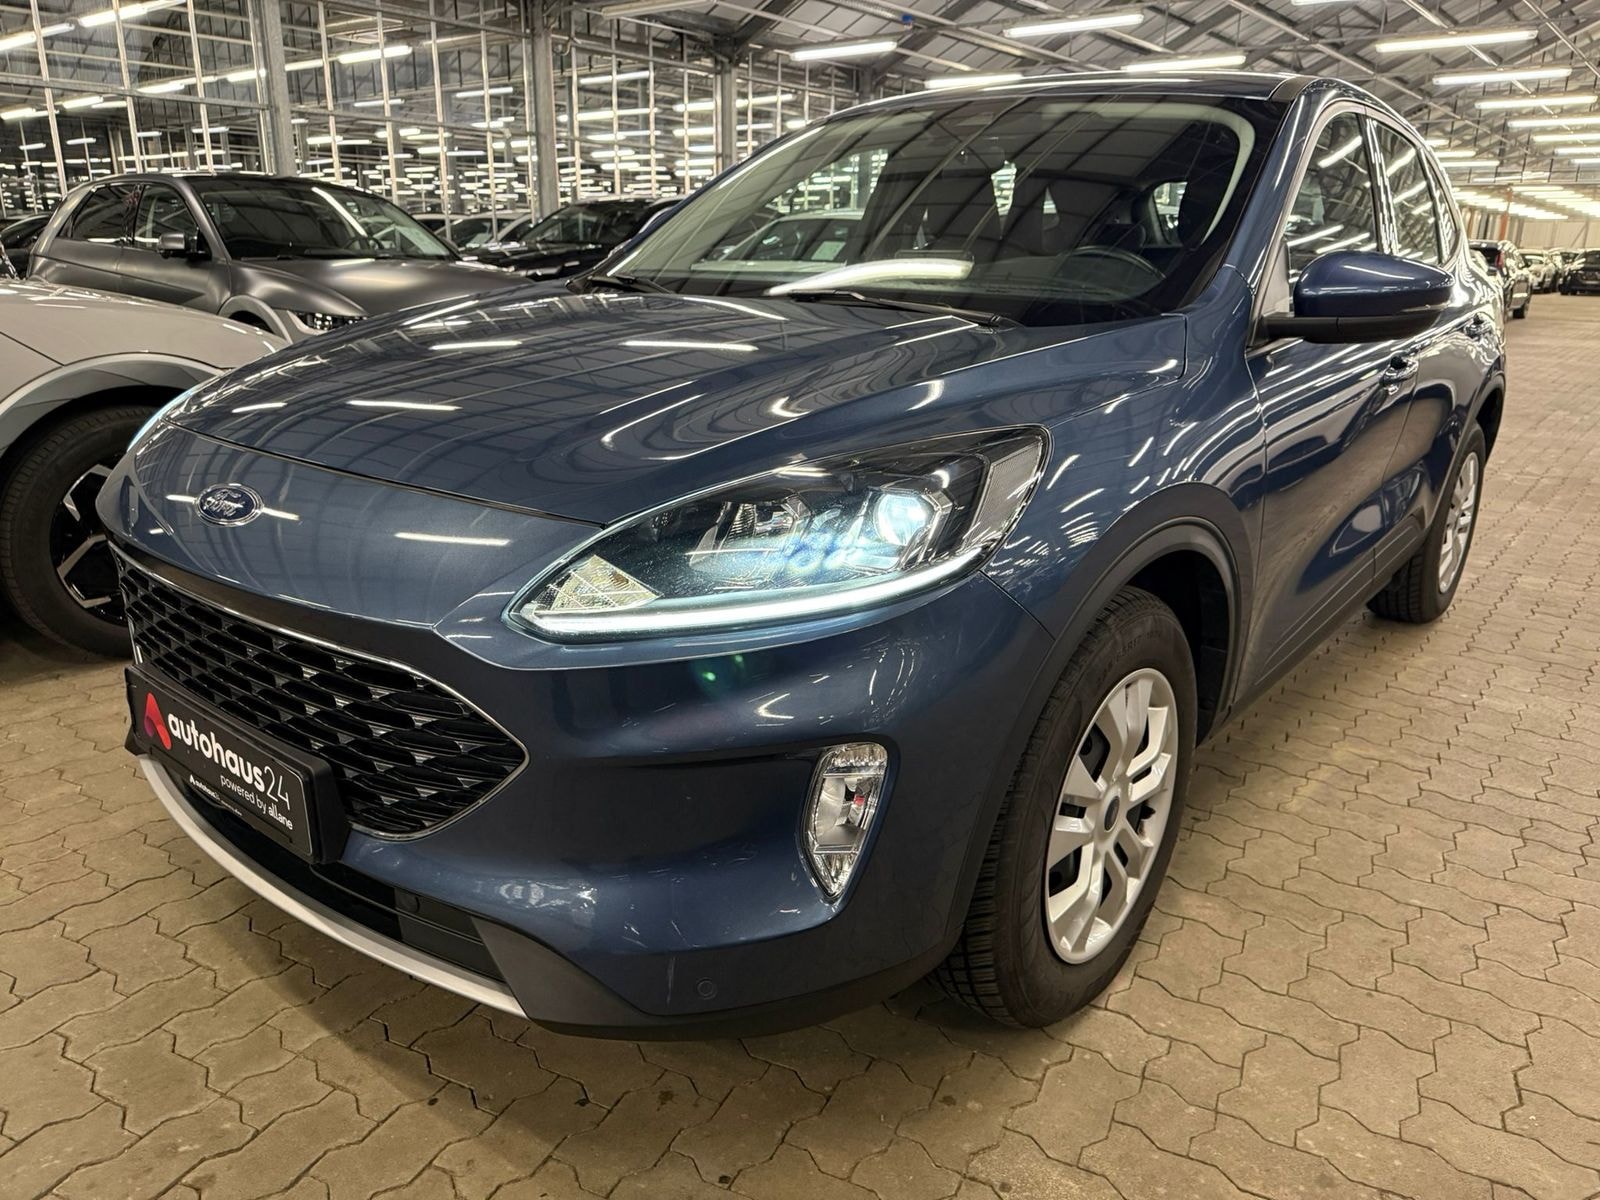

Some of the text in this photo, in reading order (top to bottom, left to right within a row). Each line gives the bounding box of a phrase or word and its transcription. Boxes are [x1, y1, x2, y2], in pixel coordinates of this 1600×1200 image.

[203, 488, 246, 517] Ford
[168, 713, 291, 811] autohaus24
[220, 775, 255, 805] powered
[255, 794, 267, 814] by
[268, 803, 293, 830] allane
